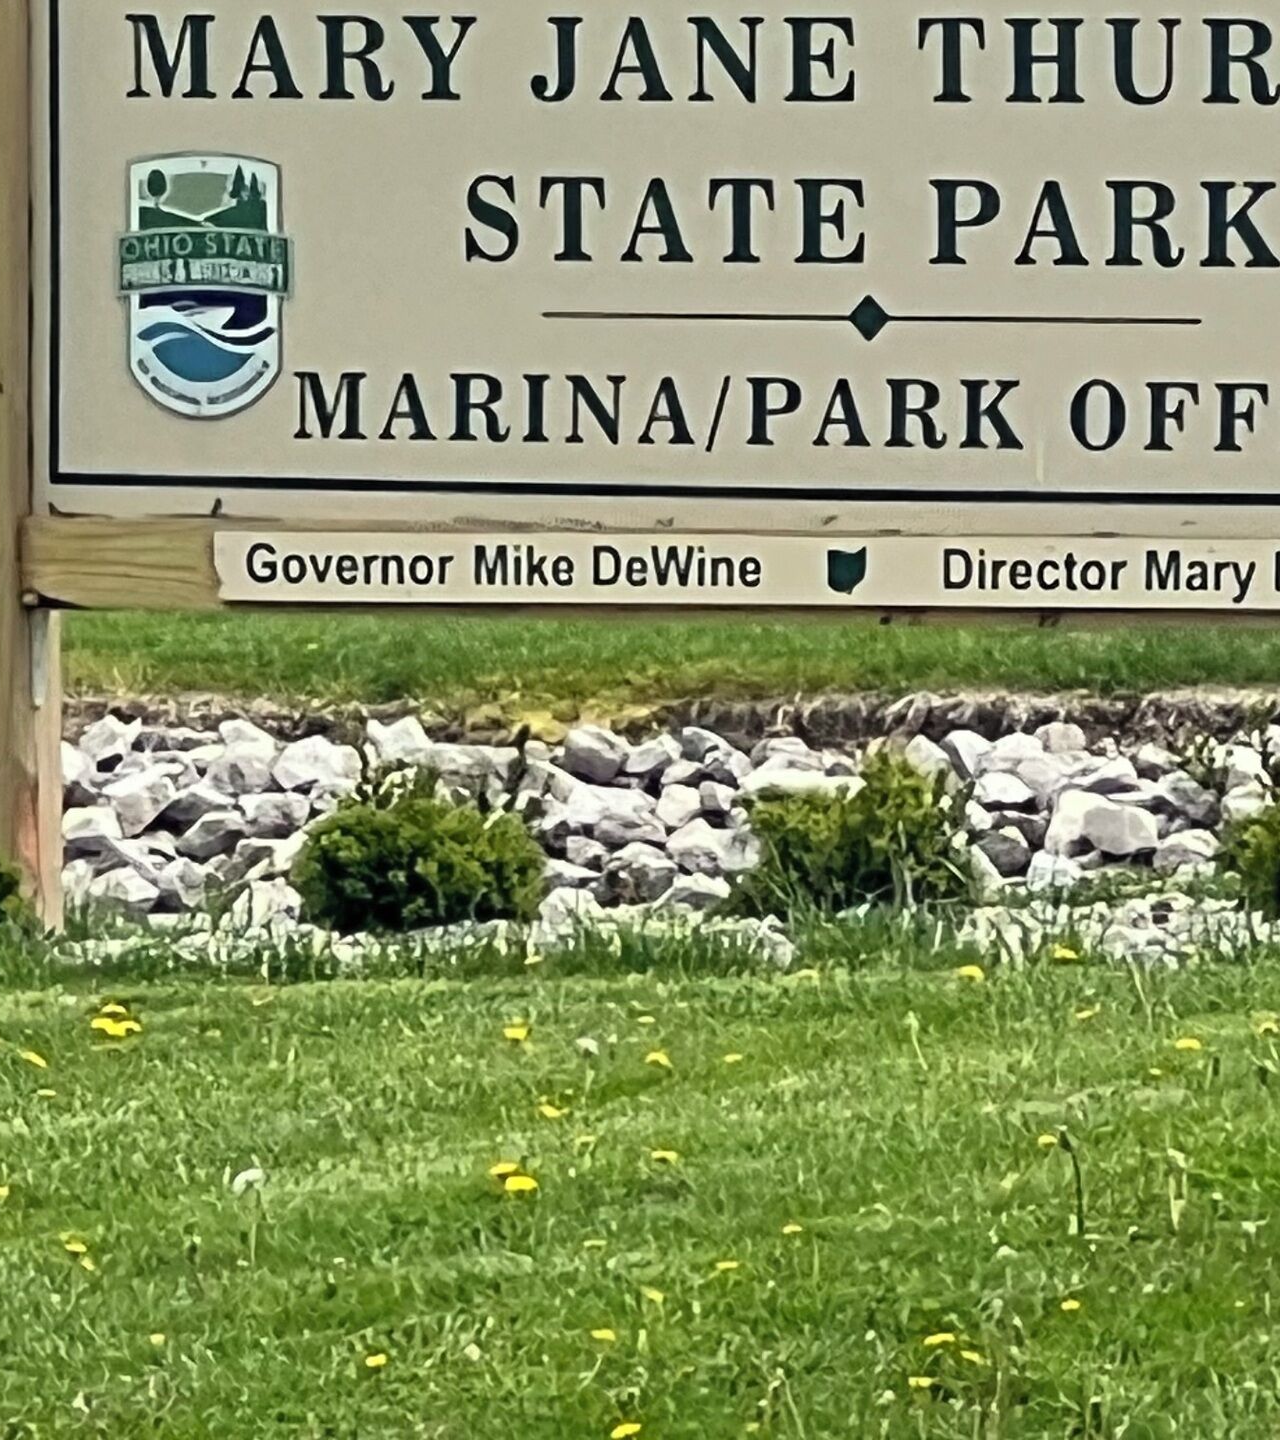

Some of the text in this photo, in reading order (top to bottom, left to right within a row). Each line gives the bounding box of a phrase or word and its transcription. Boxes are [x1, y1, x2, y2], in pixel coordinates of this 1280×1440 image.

[124, 13, 478, 102] MARY
[530, 16, 855, 104] JANE
[122, 233, 285, 259] OHIO STATE
[464, 173, 866, 265] STATE
[293, 370, 1024, 453] MARINA/PARK
[245, 542, 762, 589] Governor Mike DeWine
[943, 548, 1128, 592] Director
[1145, 549, 1256, 604] Mary
